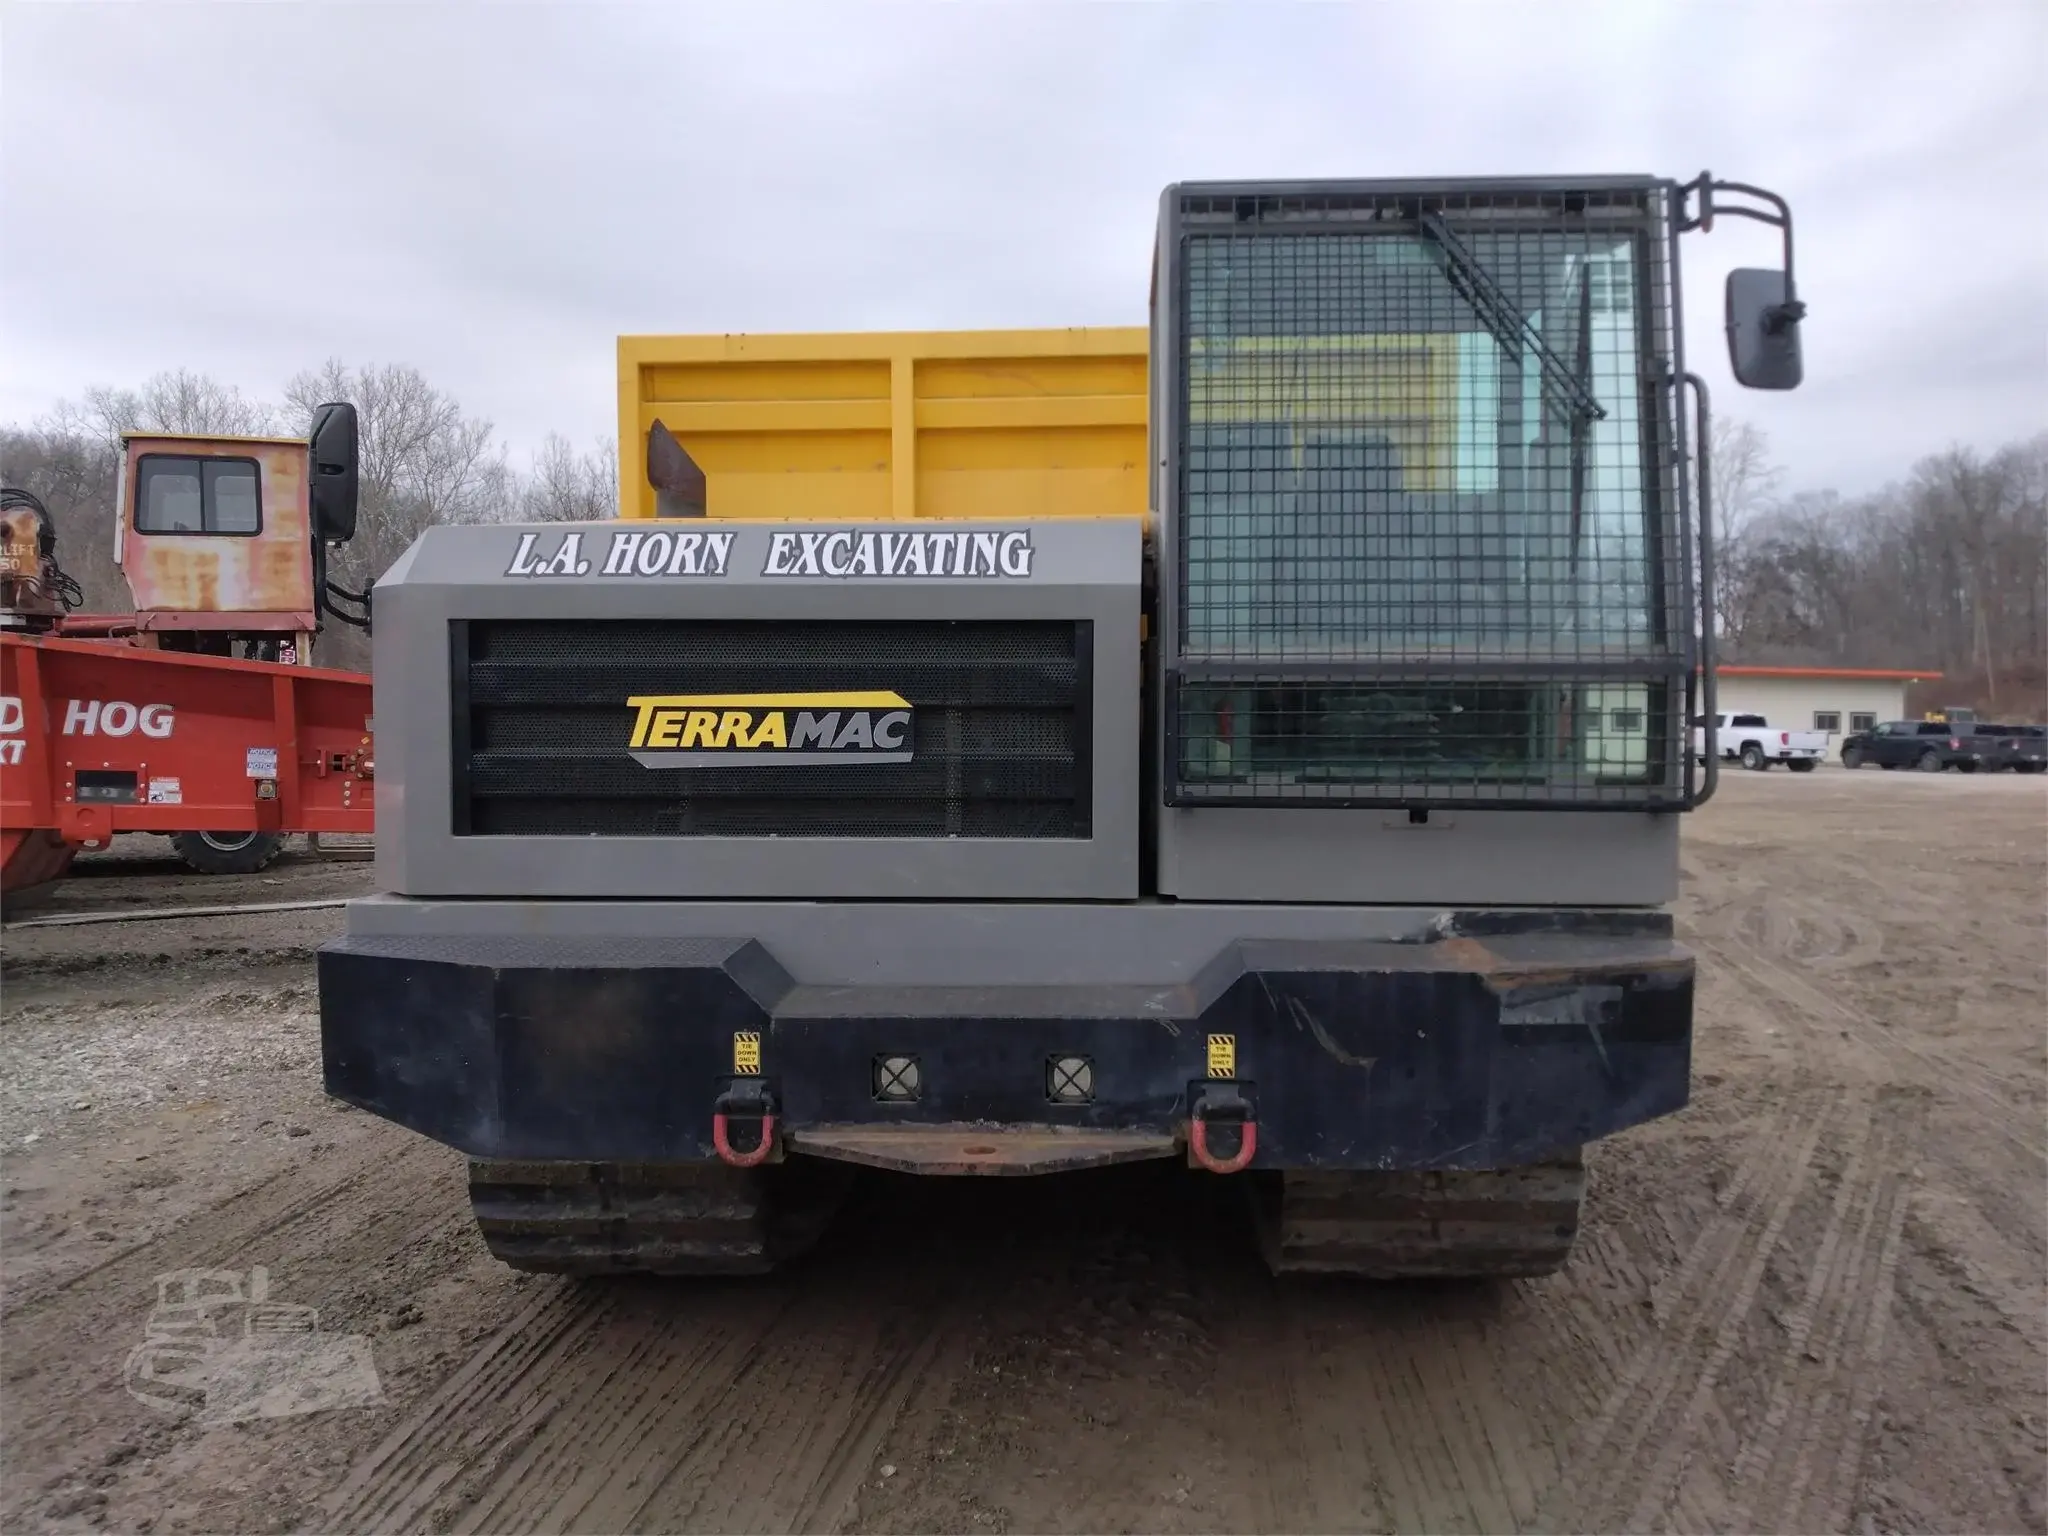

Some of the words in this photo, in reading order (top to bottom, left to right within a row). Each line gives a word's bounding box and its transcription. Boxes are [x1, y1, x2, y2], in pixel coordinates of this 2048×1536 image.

[505, 532, 592, 577] L.A.
[599, 532, 737, 577] HORN
[761, 529, 1035, 577] EXCAVATING
[62, 699, 175, 738] HOG
[626, 691, 913, 749] TERRAMAC
